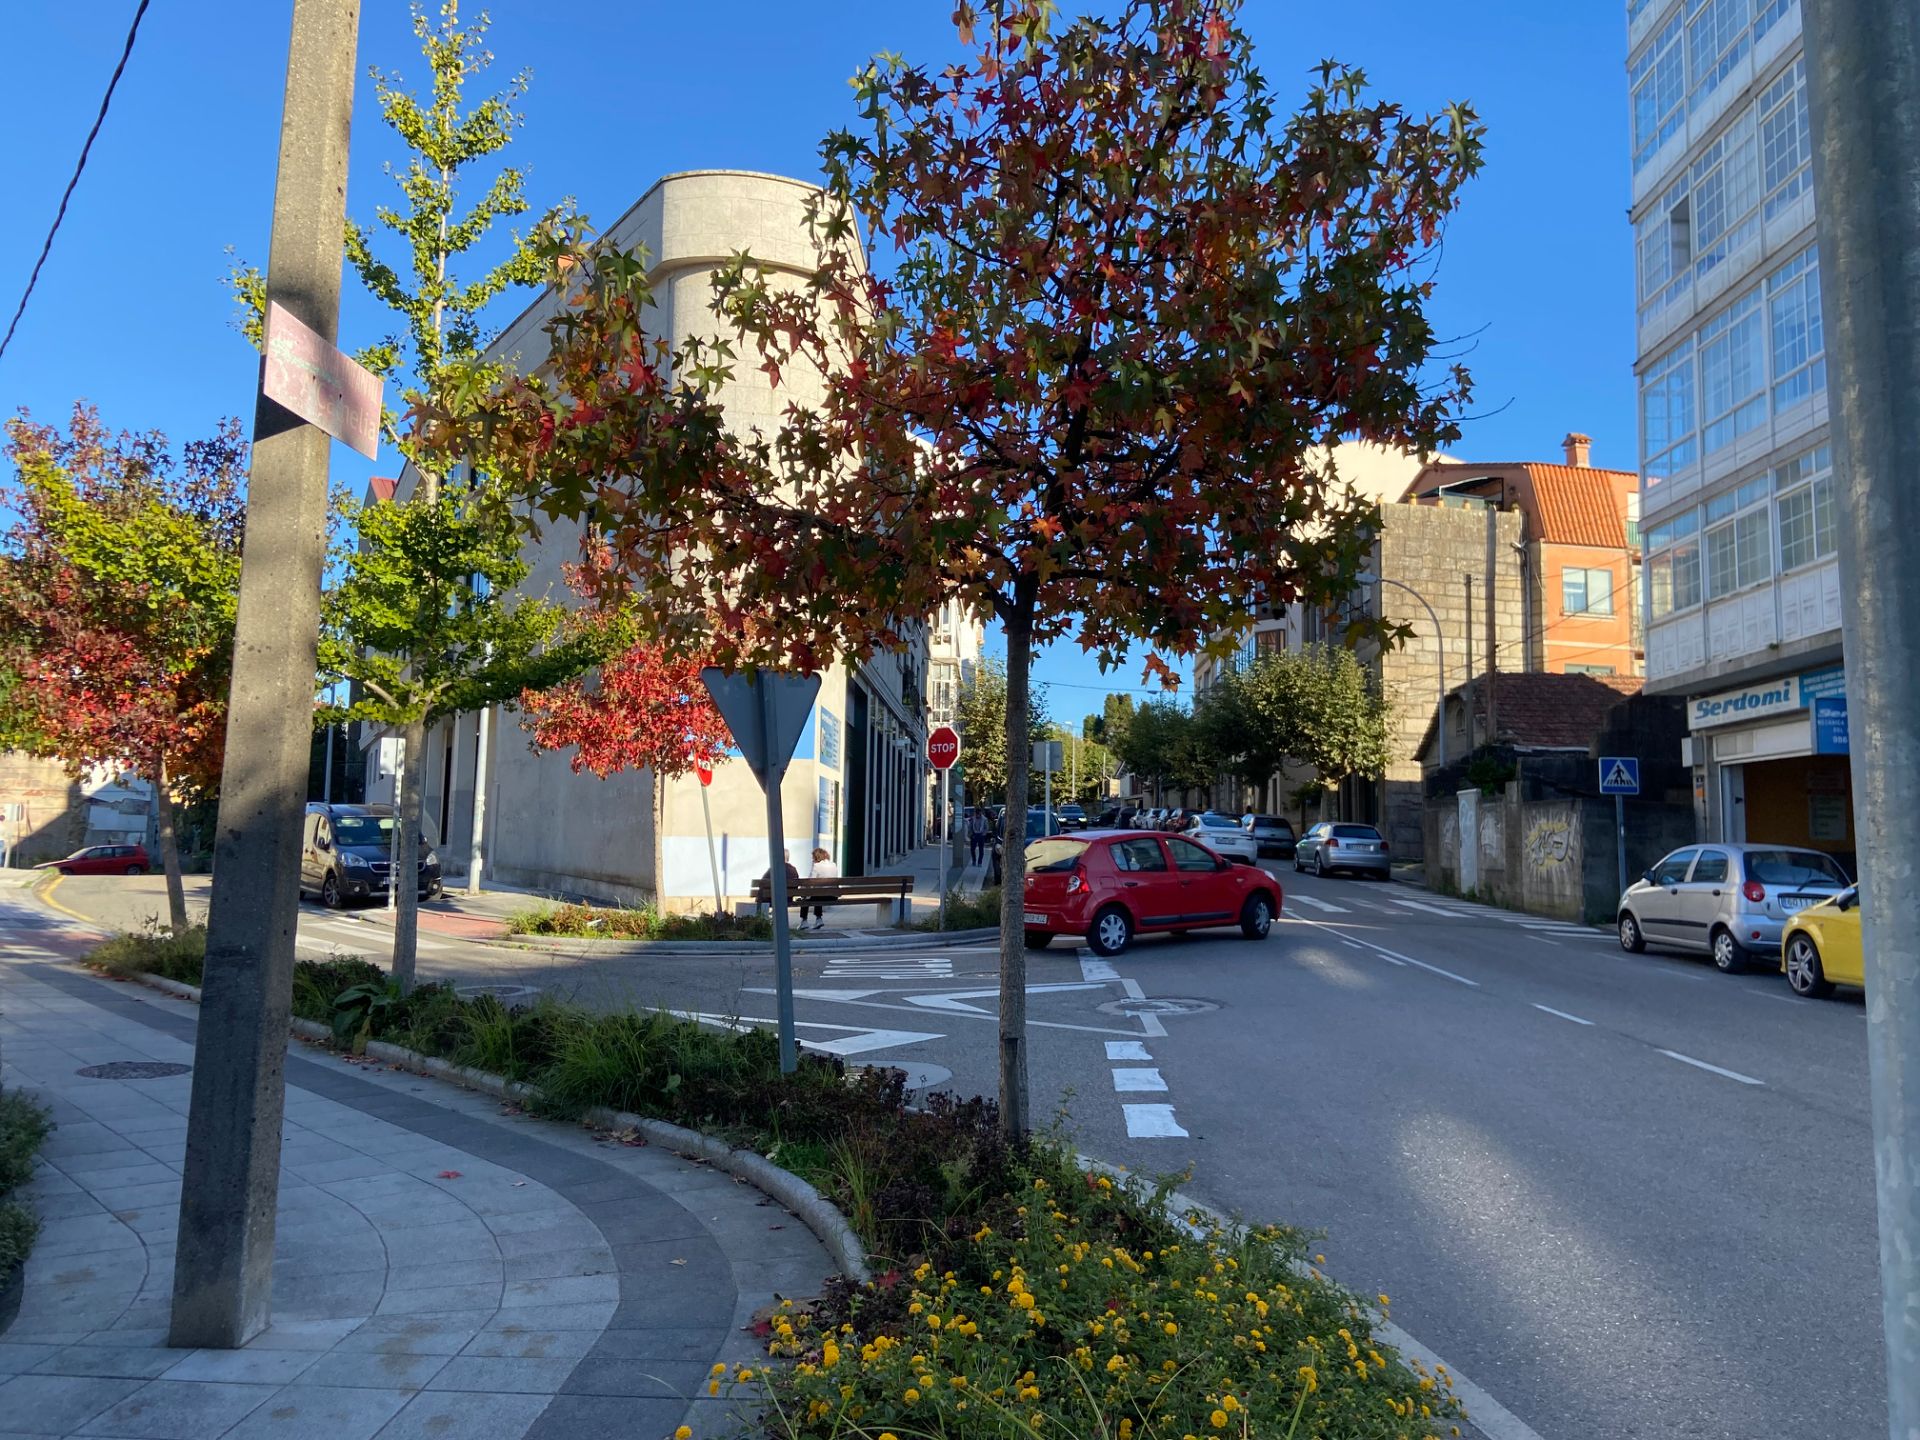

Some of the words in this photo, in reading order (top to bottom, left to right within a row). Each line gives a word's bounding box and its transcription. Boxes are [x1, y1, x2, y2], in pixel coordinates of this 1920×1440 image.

[1695, 681, 1791, 720] Serdomi
[1818, 708, 1849, 718] Ser
[931, 743, 955, 753] STOP
[819, 958, 954, 980] STOP
